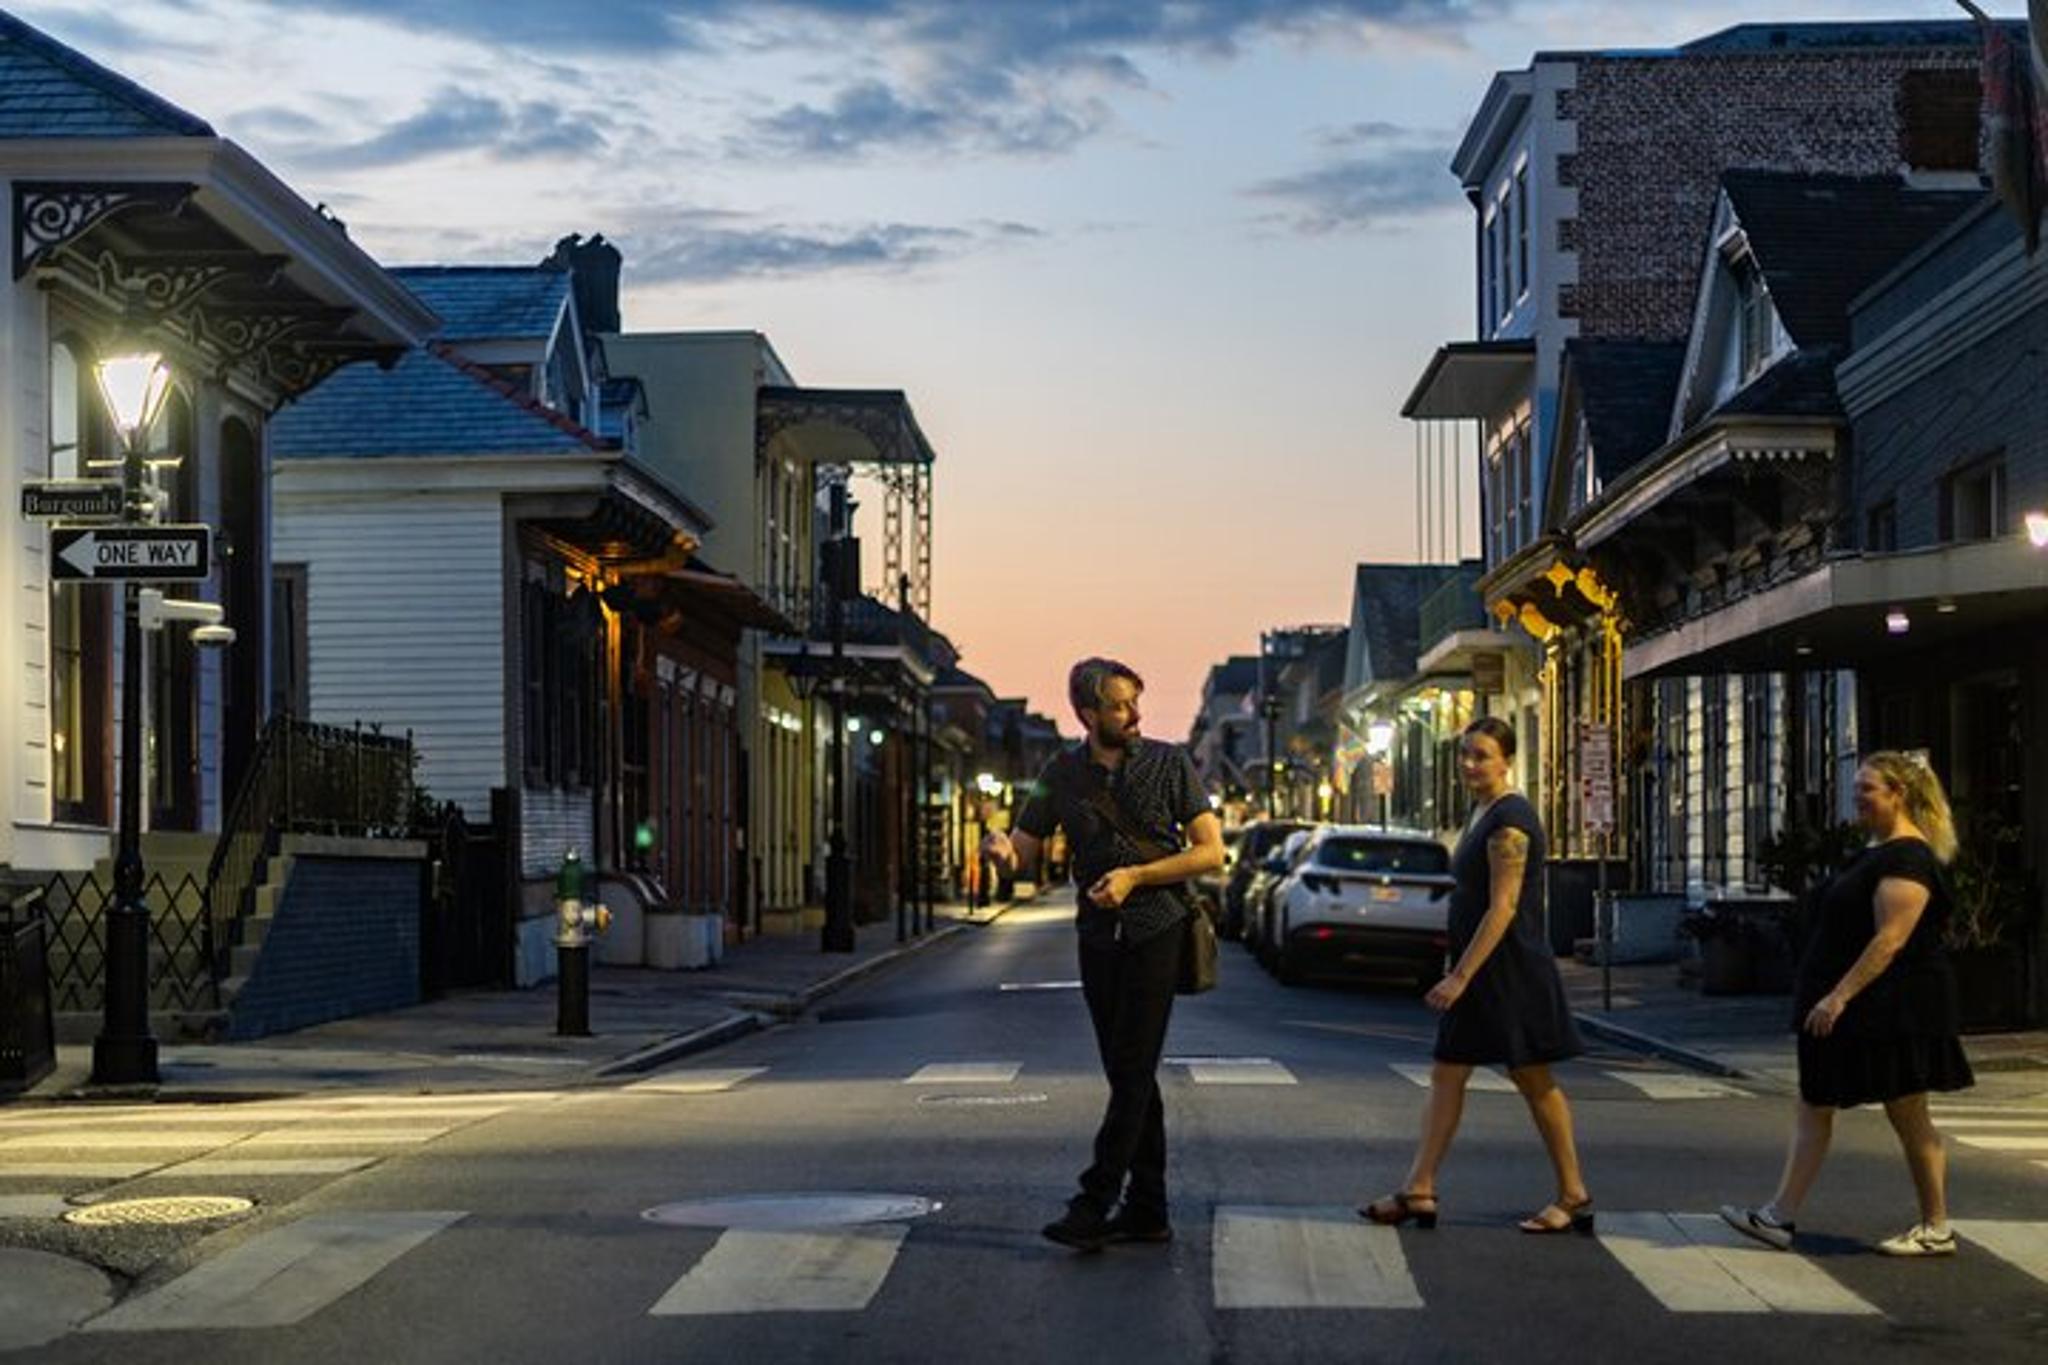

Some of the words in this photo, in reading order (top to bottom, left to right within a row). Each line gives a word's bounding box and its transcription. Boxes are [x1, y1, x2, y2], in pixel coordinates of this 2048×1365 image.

[25, 494, 119, 517] Burgundy
[97, 543, 139, 564] ONE
[148, 542, 191, 563] WAY
